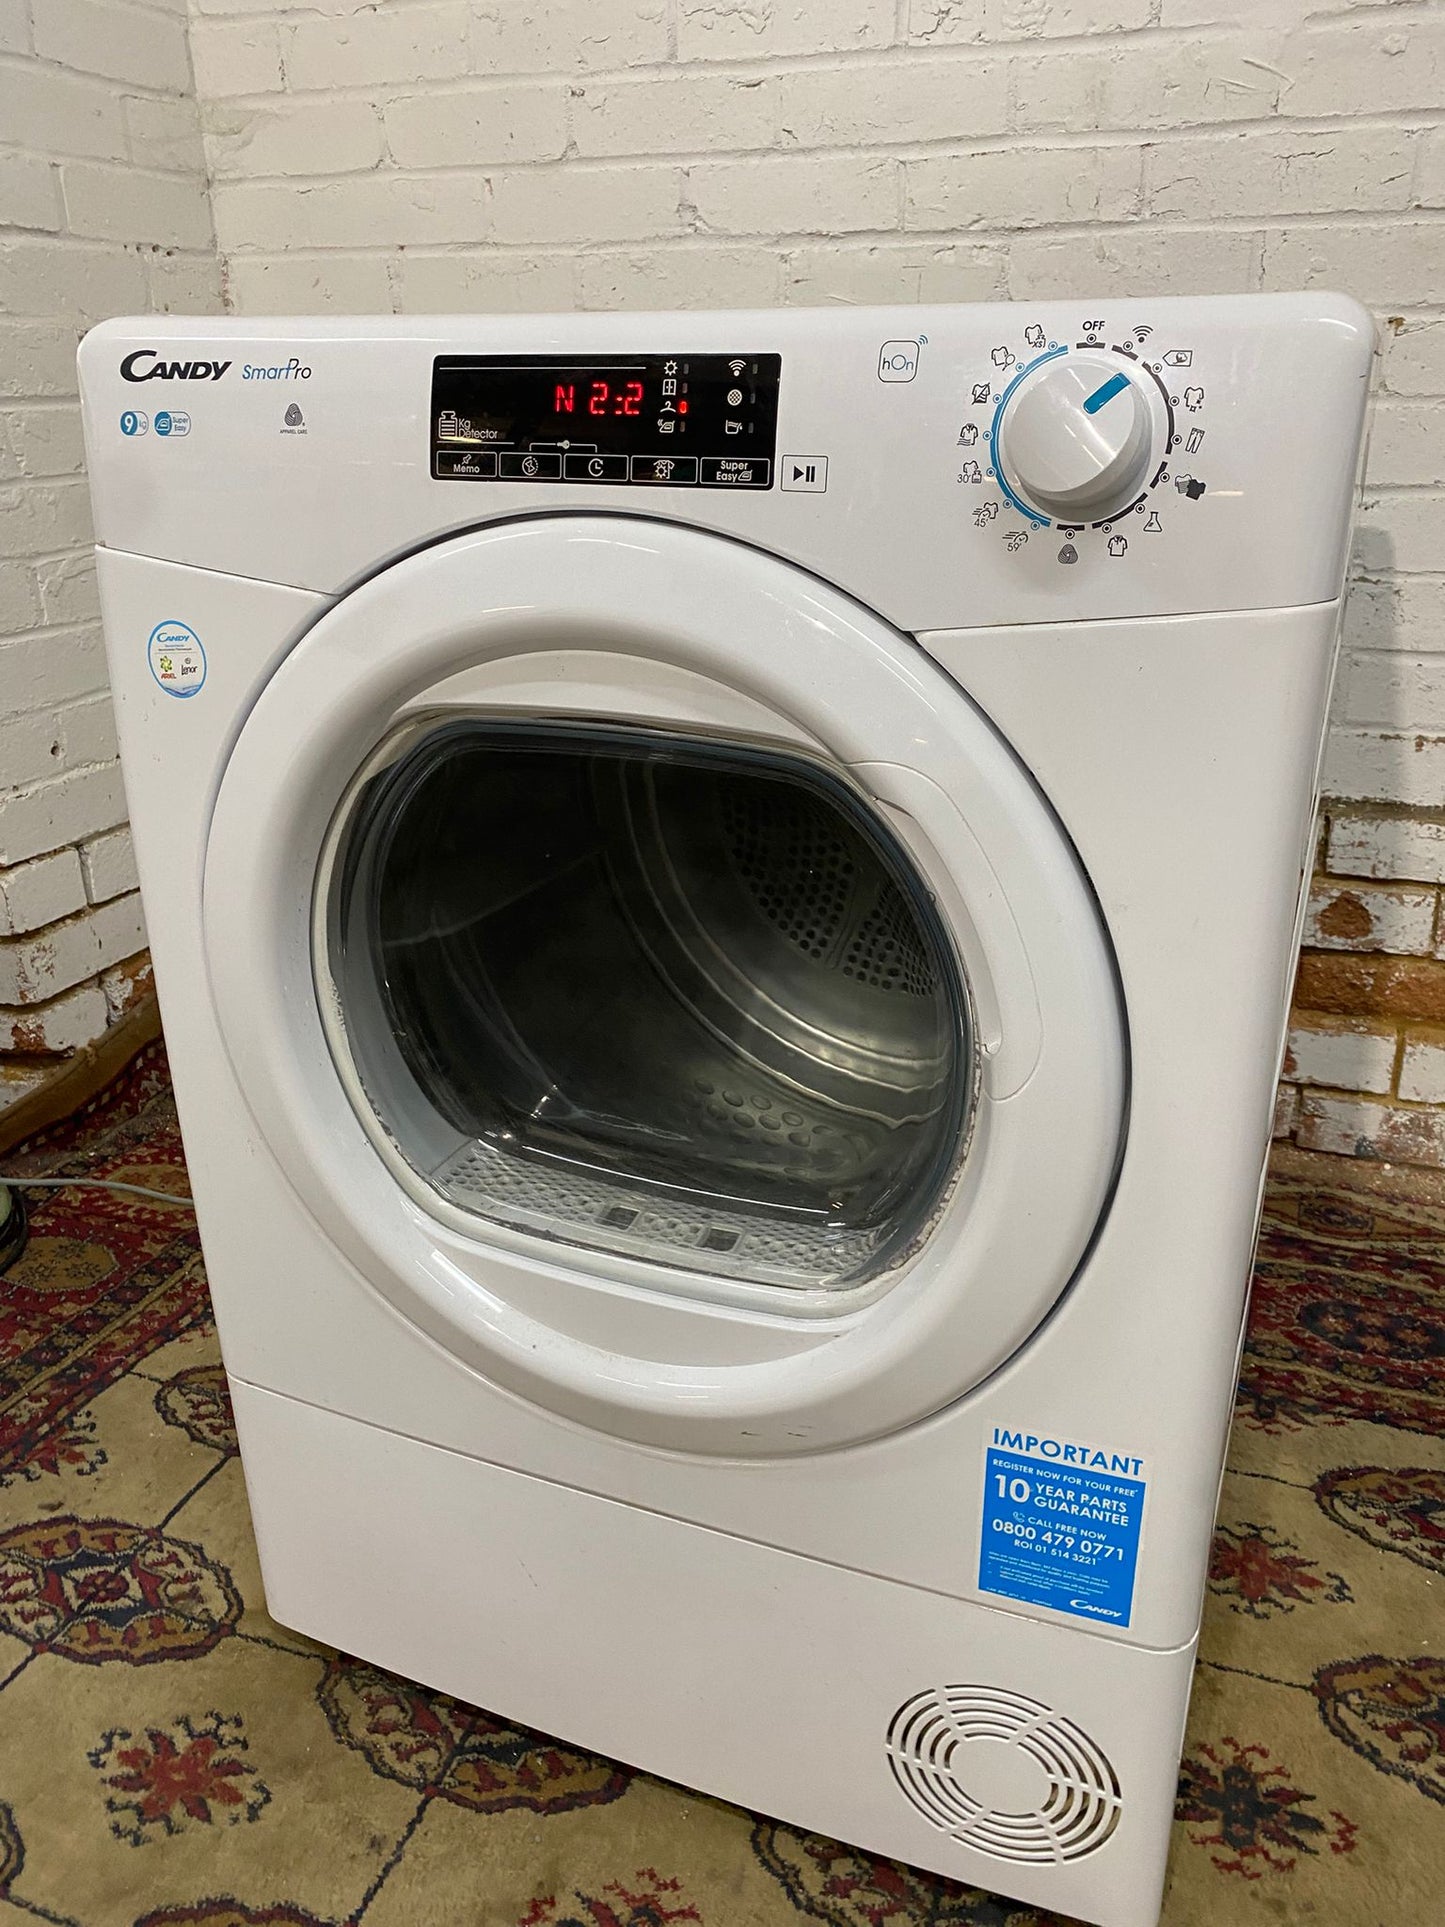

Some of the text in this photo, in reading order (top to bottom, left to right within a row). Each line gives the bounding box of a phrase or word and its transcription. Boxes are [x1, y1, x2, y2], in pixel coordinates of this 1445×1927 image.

[1082, 320, 1106, 331] OFF
[120, 349, 233, 382] CANDY
[882, 354, 914, 370] hOn
[556, 385, 574, 412] N
[124, 415, 134, 432] 9
[458, 418, 471, 431] Kg
[458, 429, 498, 439] Detector
[453, 464, 480, 473] Memo
[720, 460, 748, 471] Super
[716, 471, 737, 482] Easy
[993, 1428, 1143, 1476] IMPORTANT
[992, 1458, 1033, 1475] REGISTER
[1036, 1469, 1061, 1481] NOW
[1063, 1475, 1081, 1486] FOR
[1085, 1480, 1111, 1492] YOUR
[994, 1474, 1127, 1514] 10 YEAR PARTS
[1033, 1496, 1130, 1527] GUARANTEE
[1028, 1516, 1107, 1541] CALL FREE NOW
[992, 1518, 1124, 1561] 0800 479 0771
[1014, 1539, 1033, 1551] ROI
[1035, 1544, 1047, 1554] 01
[1051, 1548, 1070, 1560] 514
[1070, 1599, 1122, 1618] CANDY
